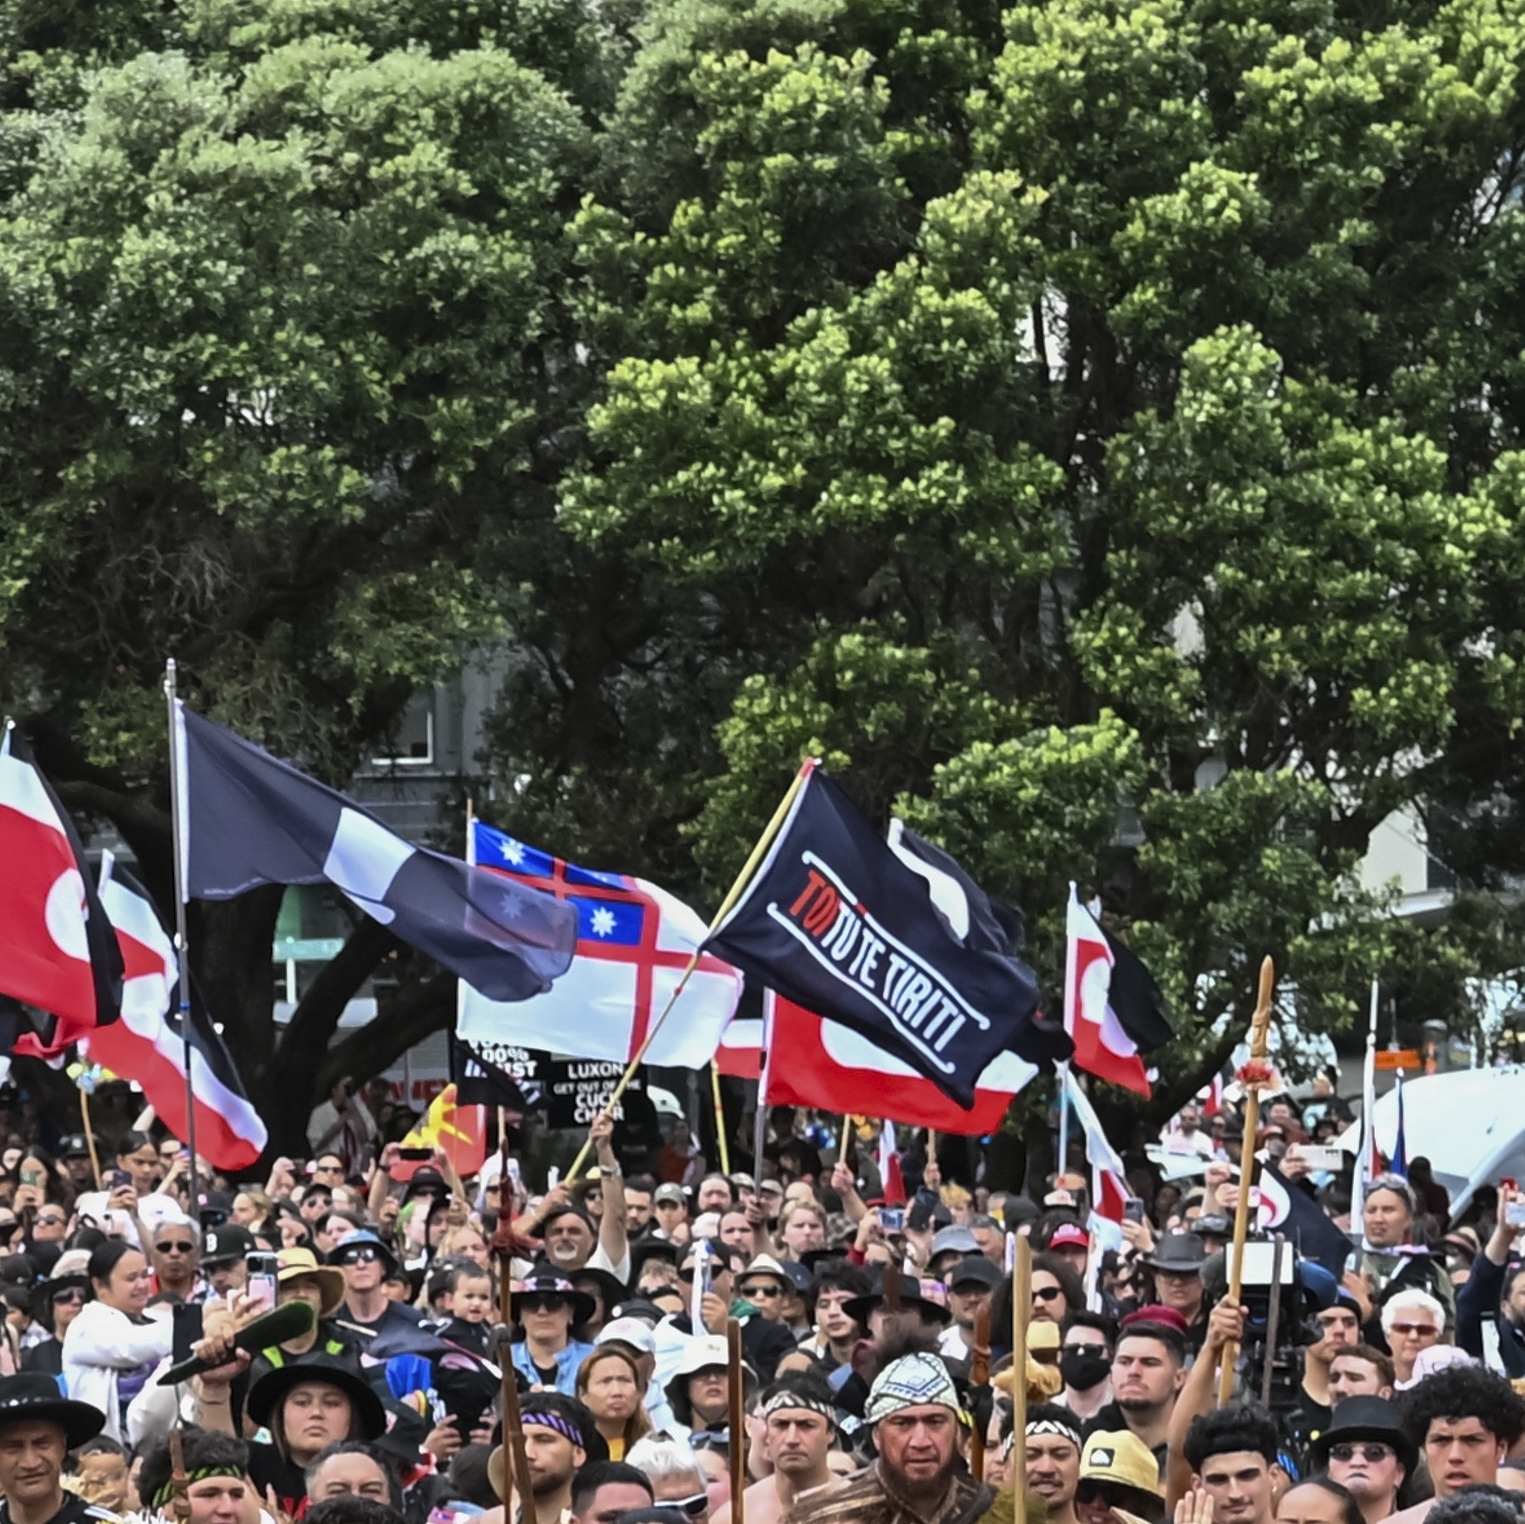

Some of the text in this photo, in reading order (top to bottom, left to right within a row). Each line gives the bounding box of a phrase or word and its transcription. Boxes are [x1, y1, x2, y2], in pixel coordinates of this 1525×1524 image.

[848, 926, 886, 989] TE
[883, 953, 966, 1053] TIRITI
[475, 1047, 530, 1063] 00%
[567, 1062, 625, 1080] LUXON
[553, 1082, 575, 1095] GET
[577, 1081, 599, 1092] OUT
[574, 1107, 625, 1123] CHR
